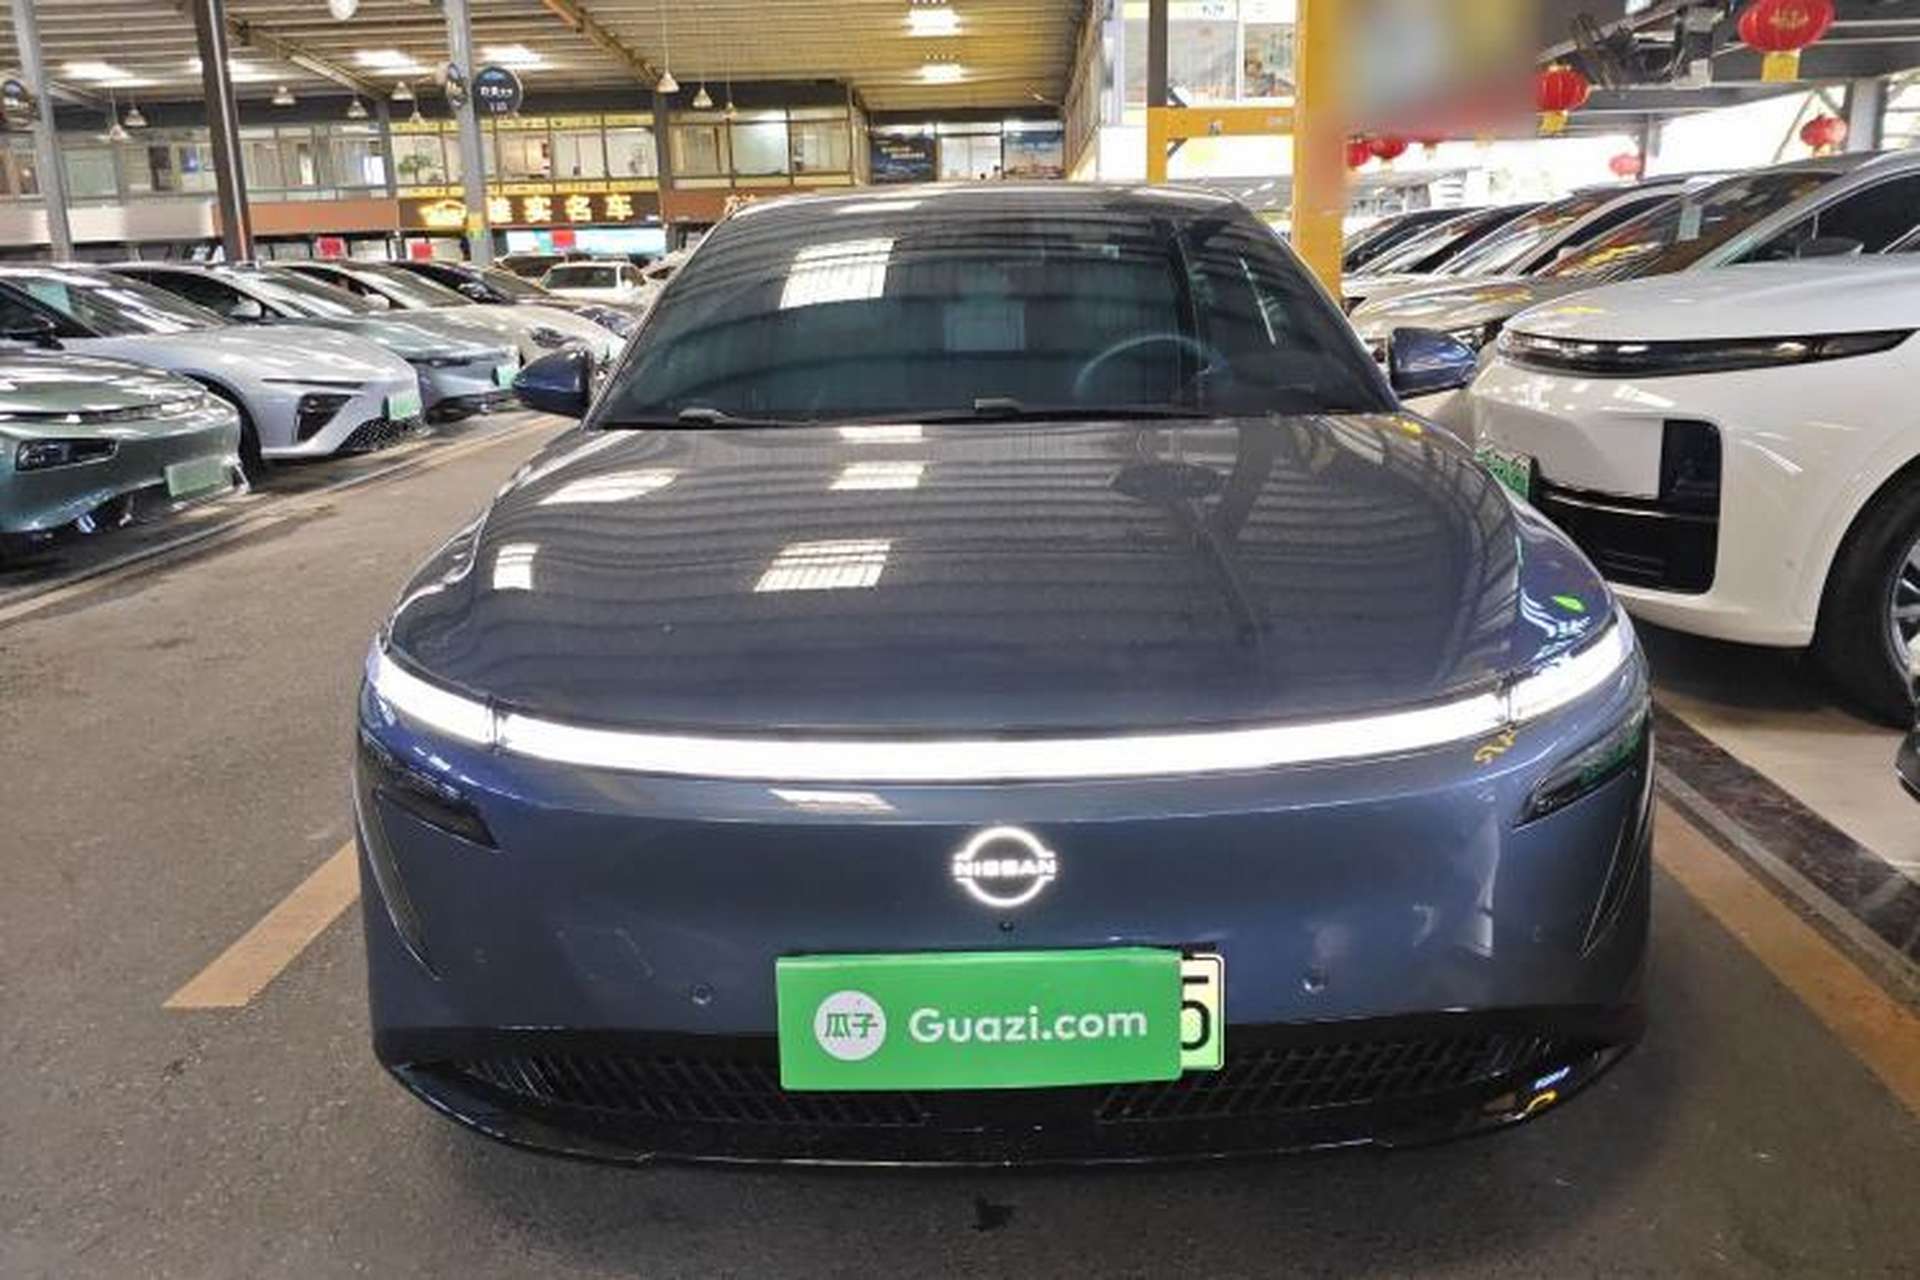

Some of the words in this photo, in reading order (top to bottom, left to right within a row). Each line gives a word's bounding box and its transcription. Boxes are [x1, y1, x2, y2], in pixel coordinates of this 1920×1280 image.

[954, 859, 1056, 877] NISSAN
[825, 1013, 878, 1038] 瓜子
[909, 1006, 1147, 1042] Guazi.com
